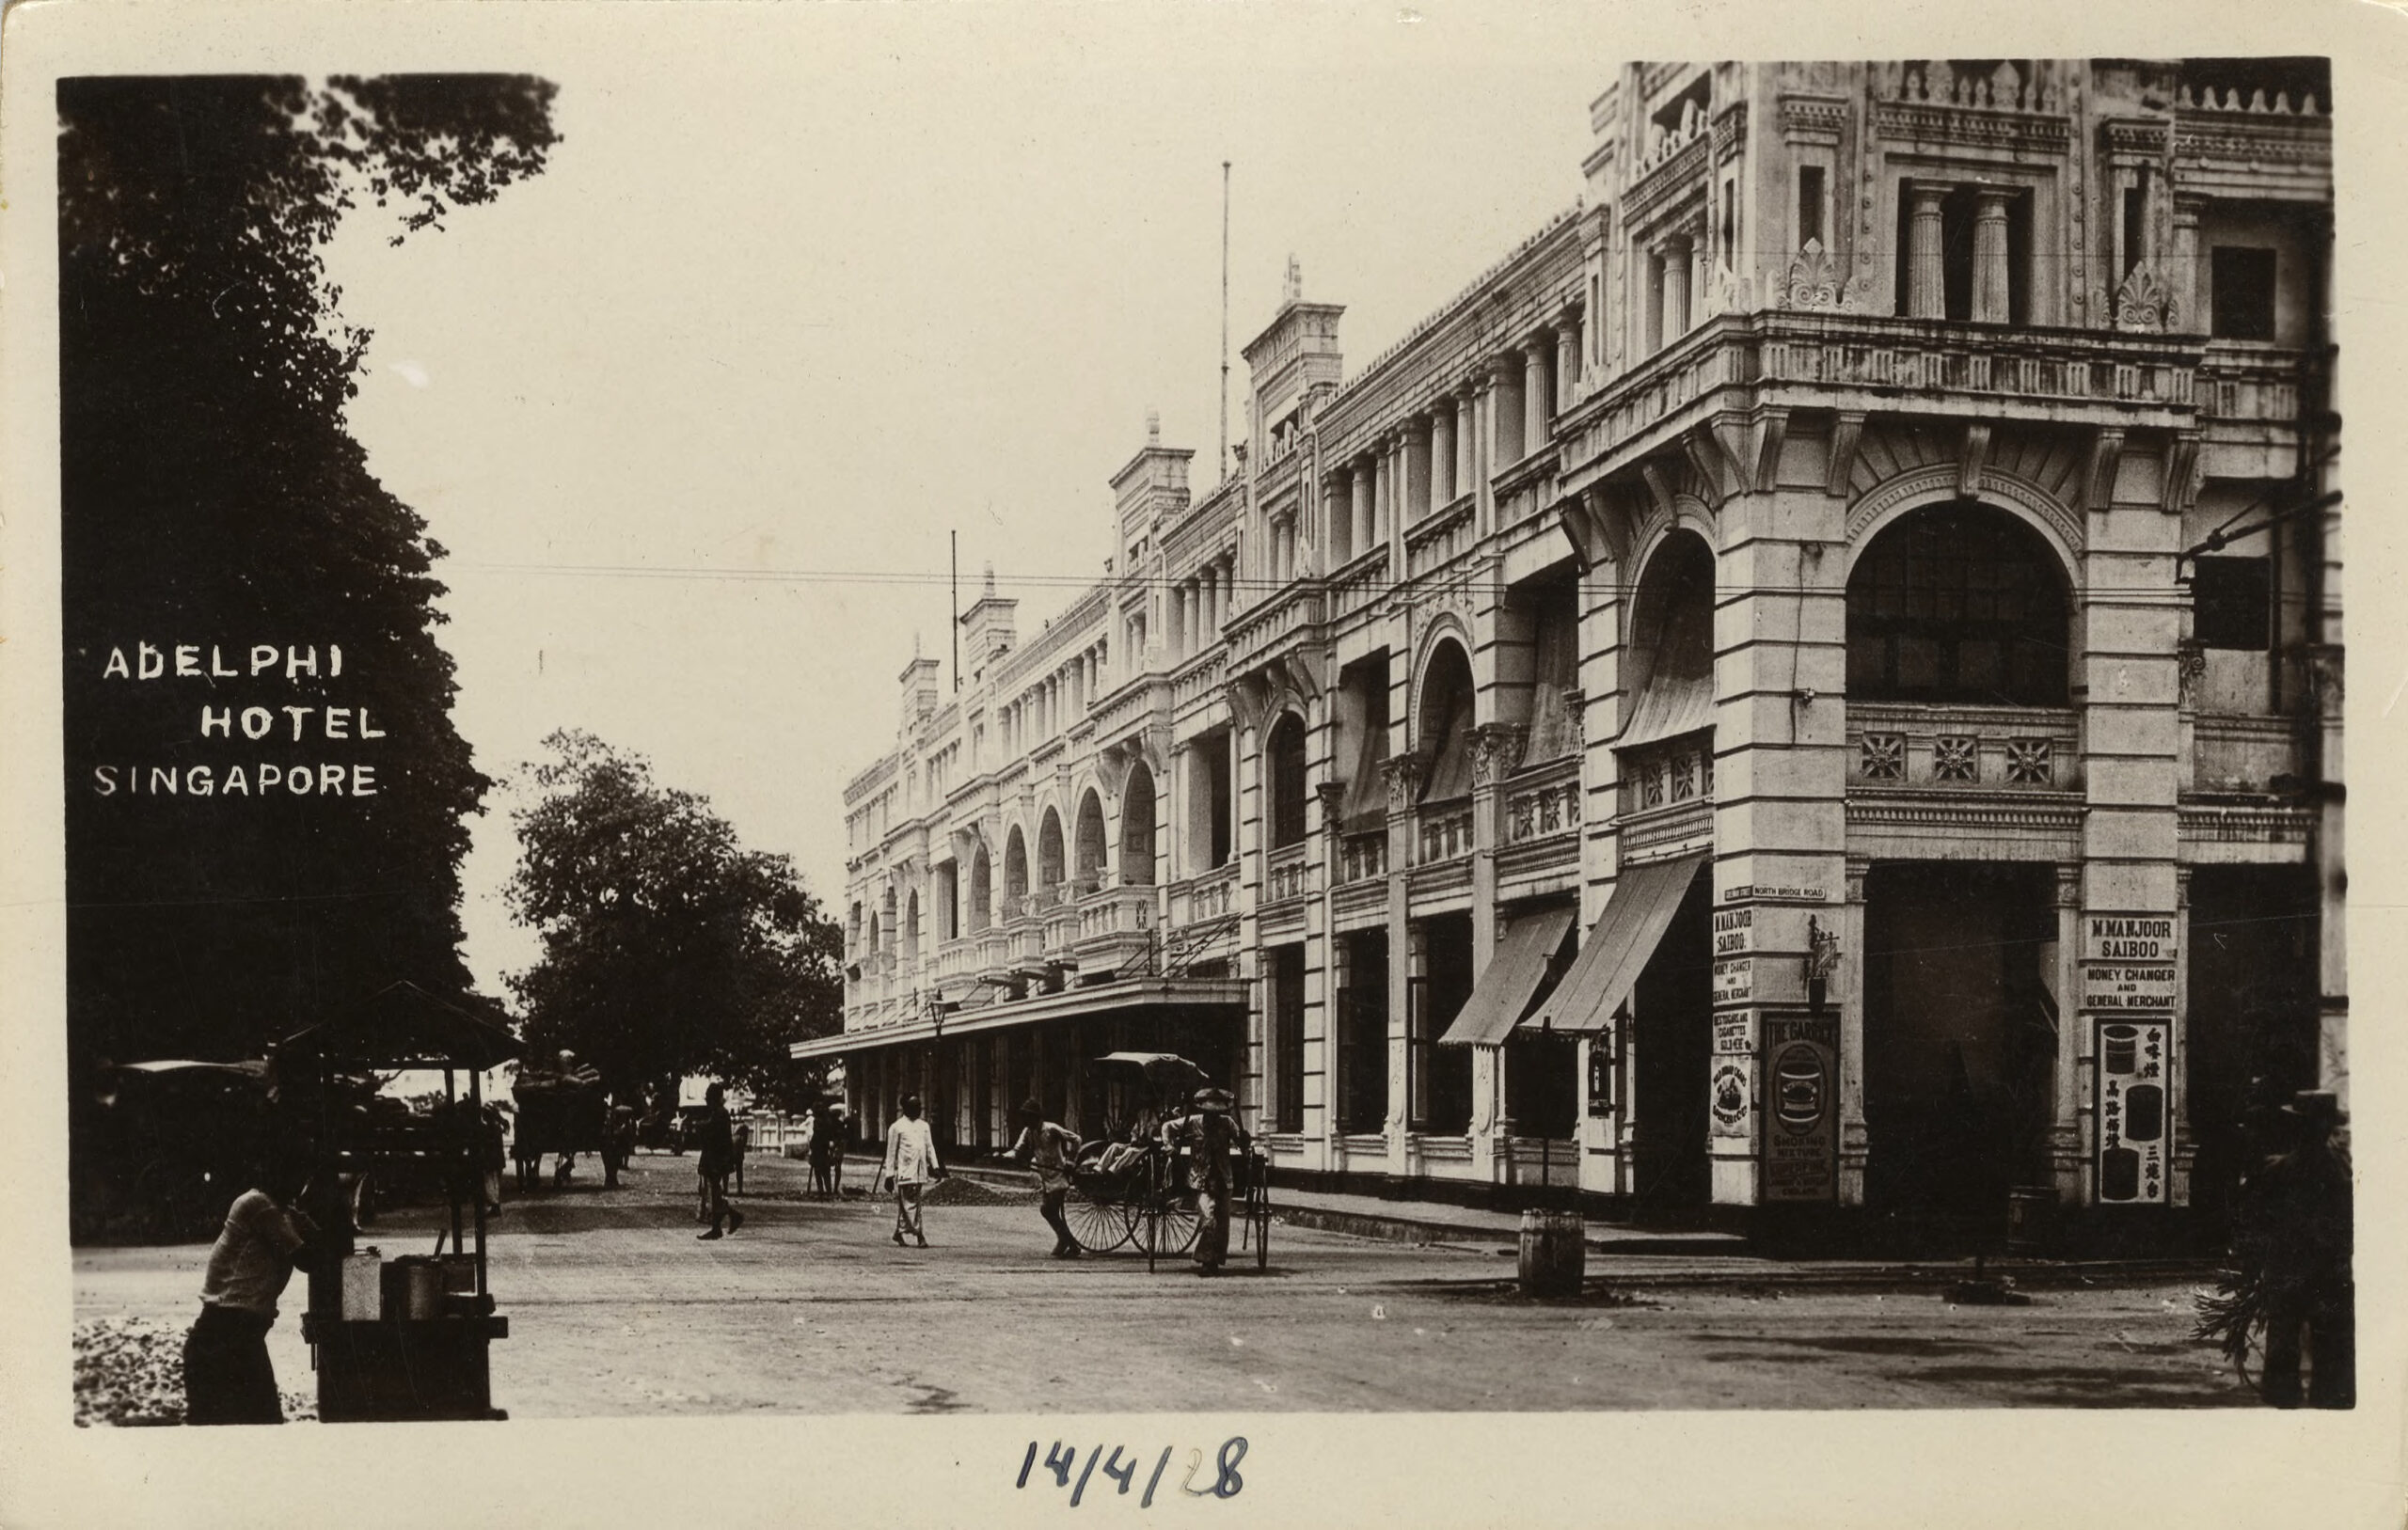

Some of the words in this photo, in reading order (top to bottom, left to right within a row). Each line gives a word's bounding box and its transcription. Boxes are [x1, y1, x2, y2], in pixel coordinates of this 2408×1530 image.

[2102, 940, 2159, 957] SAIBOO
[2088, 969, 2121, 981] MONEY
[2126, 969, 2176, 981] CHANGER
[2087, 995, 2123, 1007] GENERAL
[2127, 995, 2176, 1007] MERCHANT
[1016, 1436, 1249, 1509] 14/4/28
